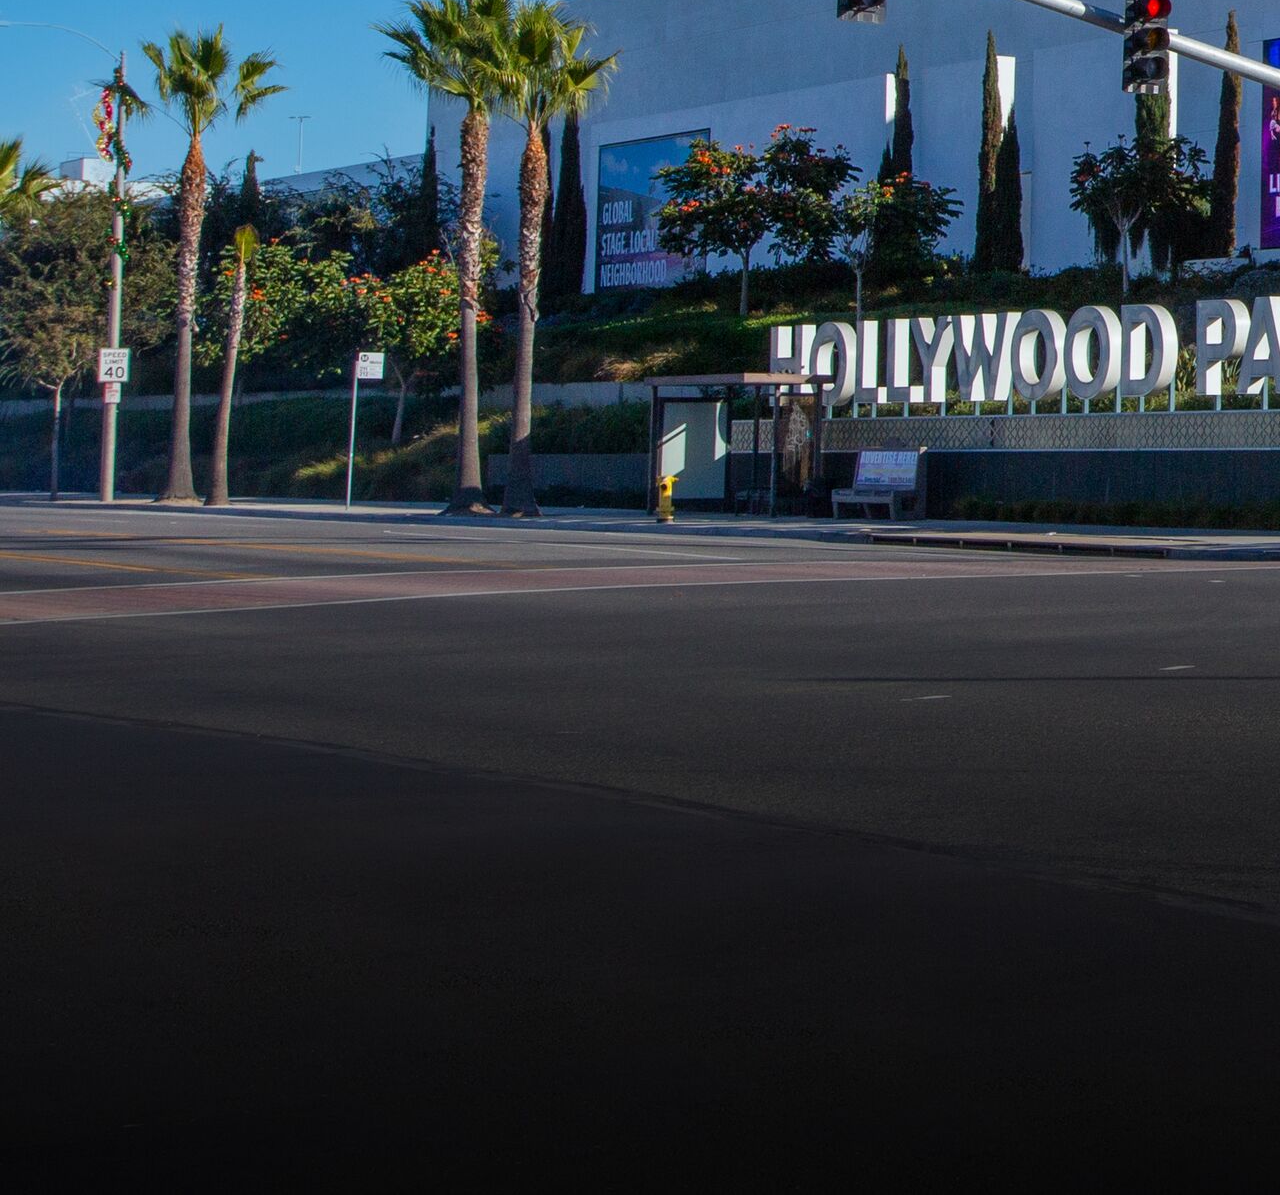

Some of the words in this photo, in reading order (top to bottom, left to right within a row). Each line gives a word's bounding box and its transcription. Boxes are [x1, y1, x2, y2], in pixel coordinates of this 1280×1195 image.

[602, 200, 634, 225] GLOBAL
[630, 228, 657, 254] LOCAL
[600, 260, 667, 287] NEIGHBORHOOD
[769, 303, 1178, 407] HOLLYWOOD
[104, 366, 125, 379] 40
